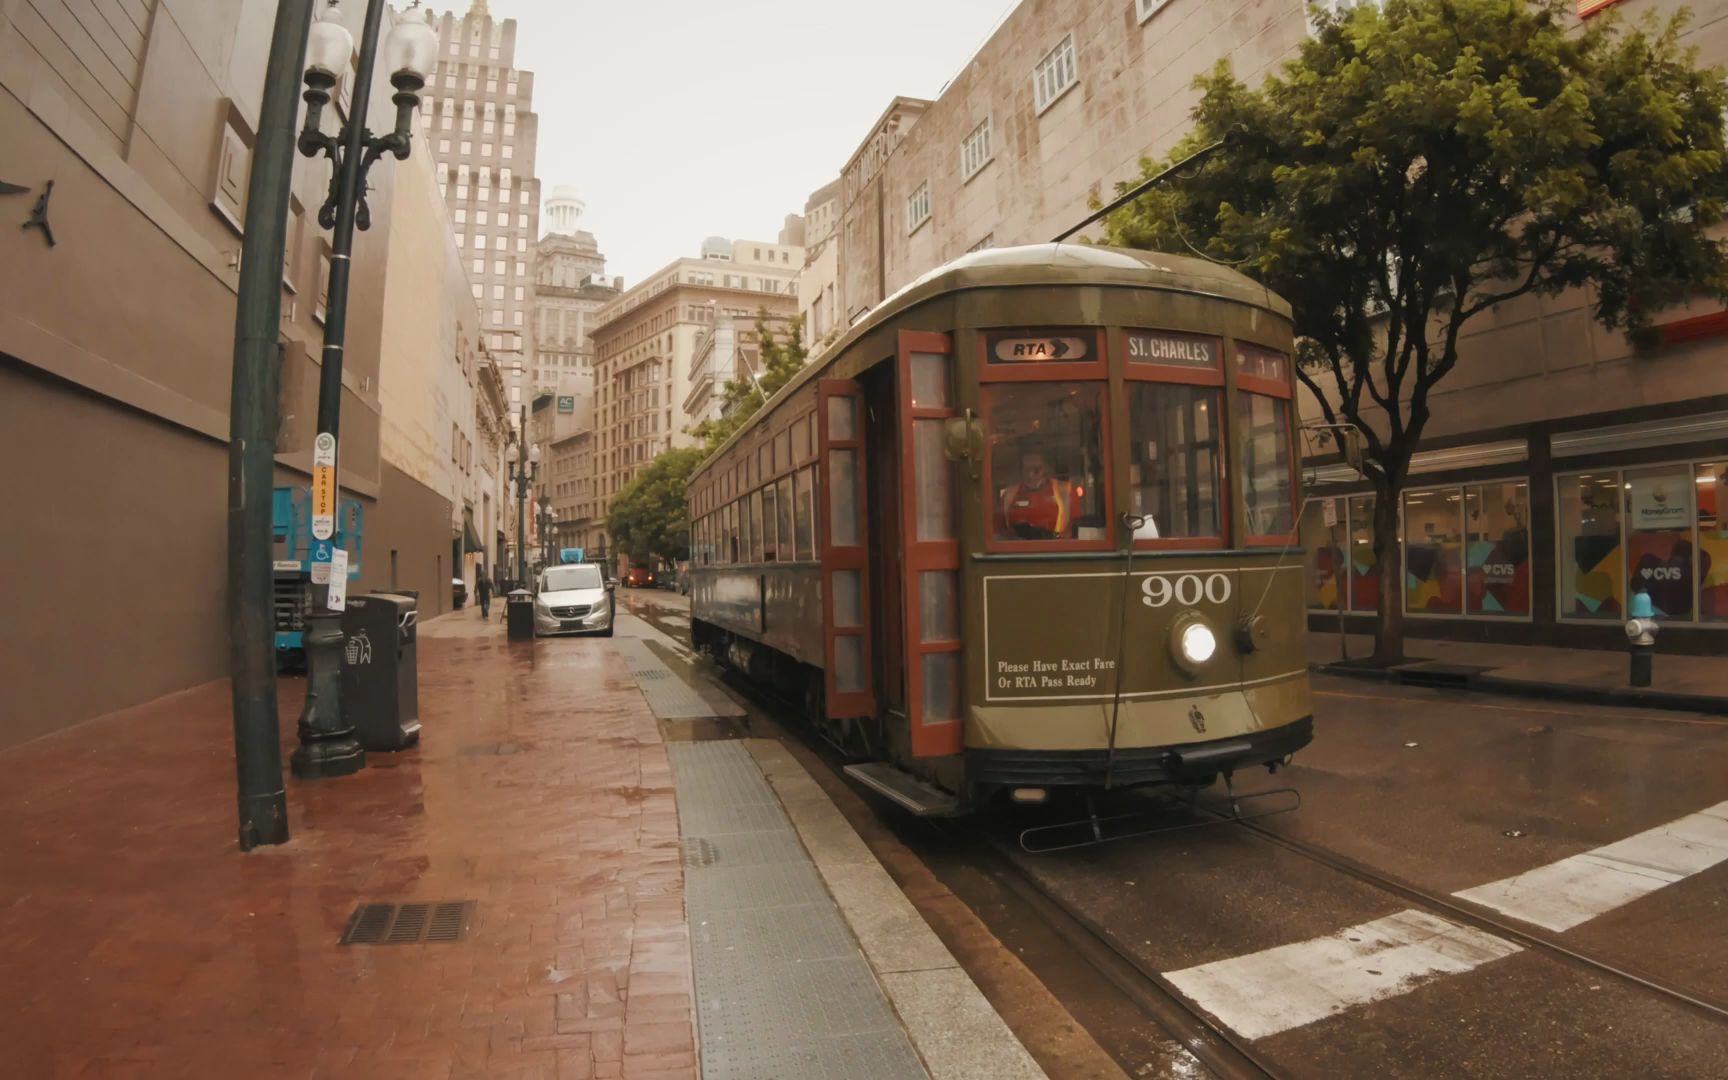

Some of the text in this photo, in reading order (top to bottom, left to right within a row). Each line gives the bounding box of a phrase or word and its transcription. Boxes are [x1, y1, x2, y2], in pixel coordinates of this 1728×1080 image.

[1013, 343, 1046, 356] RTA
[1129, 336, 1209, 362] ST. CHARLES
[1492, 563, 1514, 576] CVS
[1653, 567, 1682, 580] CVS
[1141, 573, 1232, 608] 900
[998, 658, 1115, 673] Please Have Exact Fare
[998, 674, 1097, 688] Or RTA Pass Ready
